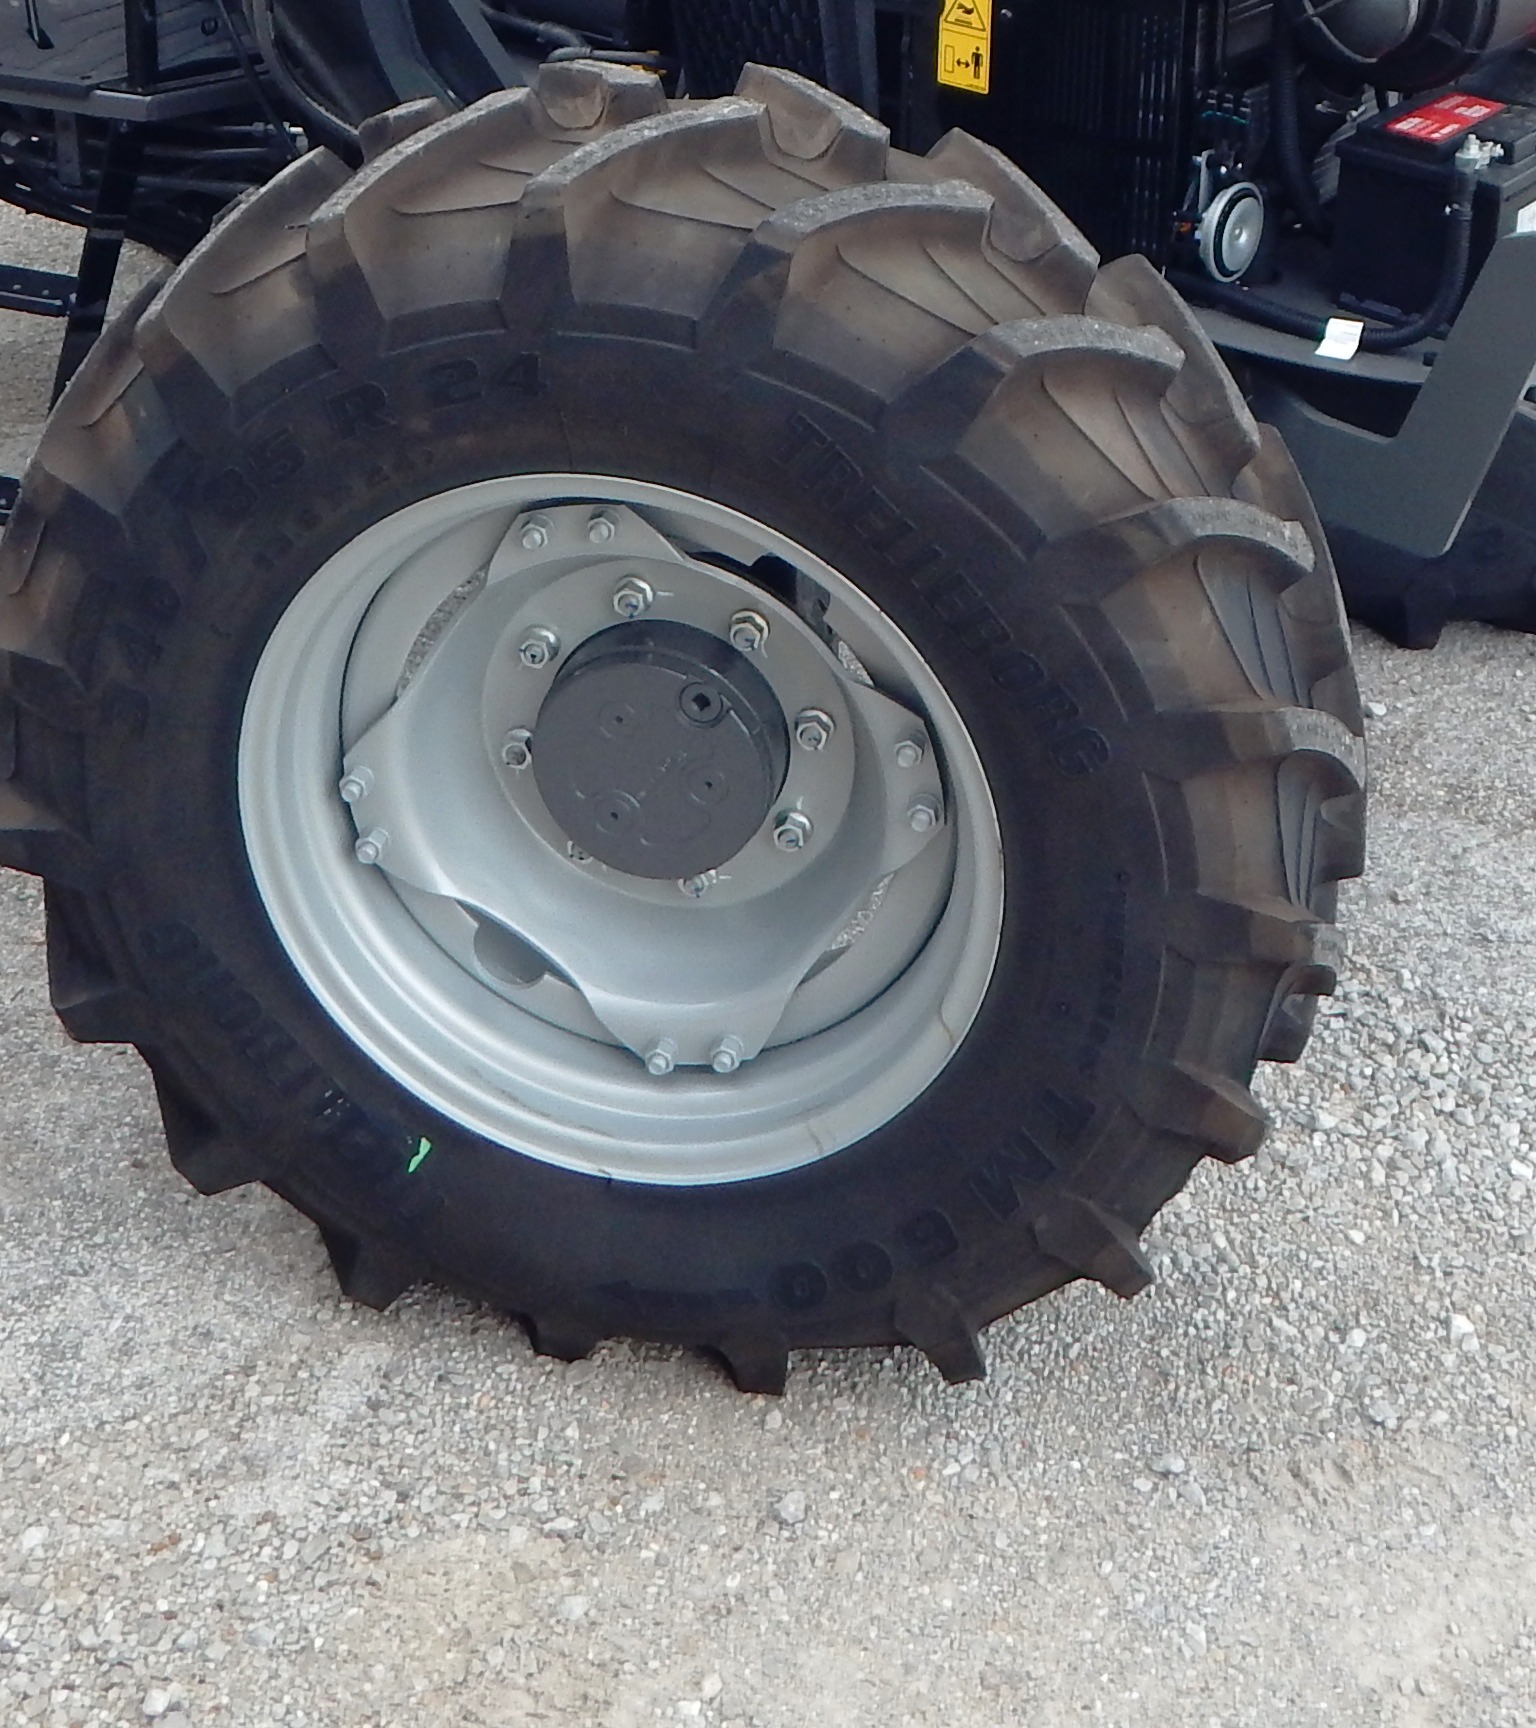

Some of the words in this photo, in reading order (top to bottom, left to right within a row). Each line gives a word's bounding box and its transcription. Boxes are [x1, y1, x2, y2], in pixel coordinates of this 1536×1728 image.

[322, 378, 398, 442] R
[418, 351, 549, 411] 24
[967, 1086, 1099, 1219] TM
[767, 1207, 960, 1314] 600
